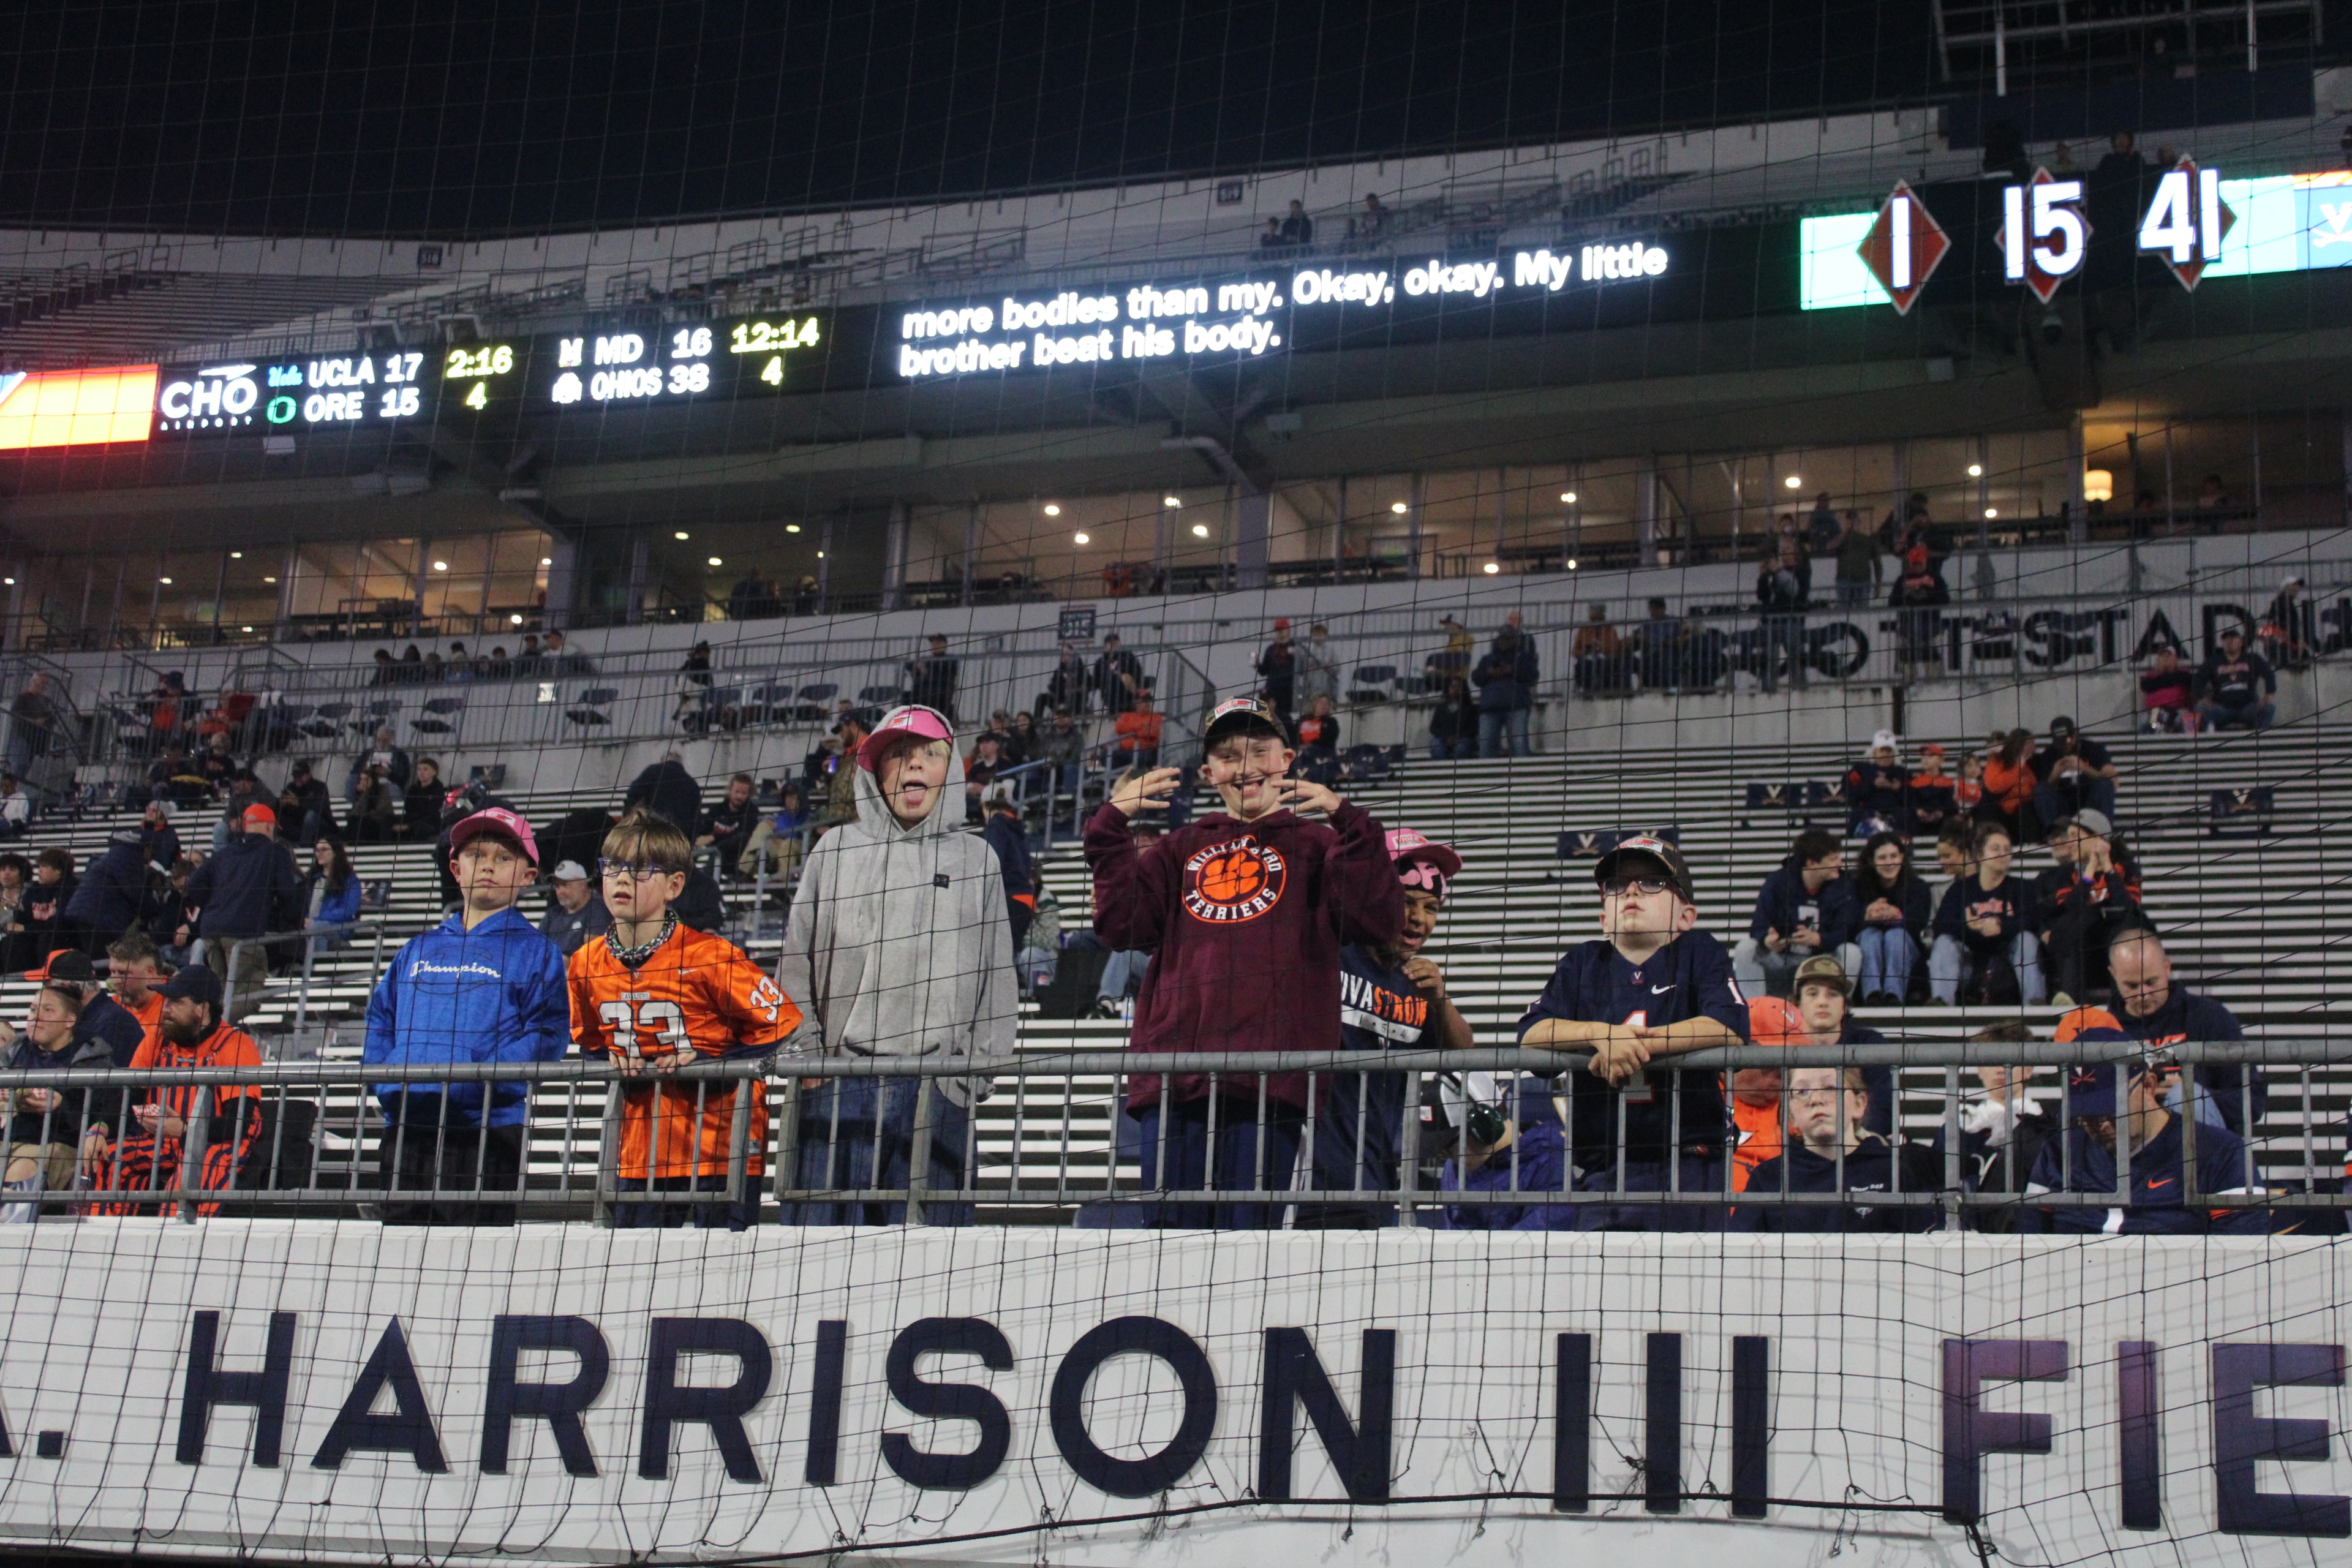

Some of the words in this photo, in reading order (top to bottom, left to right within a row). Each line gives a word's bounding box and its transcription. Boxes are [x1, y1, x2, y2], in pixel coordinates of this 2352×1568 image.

[2003, 180, 2086, 282] 15
[2138, 168, 2222, 264] 41
[902, 306, 994, 338] more
[1002, 292, 1118, 330] bodies
[1126, 285, 1208, 320] than
[1218, 281, 1283, 315] my.
[1292, 269, 1394, 306] Okay,
[1404, 260, 1504, 297] okay.
[1515, 249, 1572, 291] My
[1581, 242, 1668, 281] little
[594, 334, 644, 366] MD
[671, 327, 713, 359] 16
[730, 317, 820, 353] 12:14
[900, 338, 1027, 377] brother
[1033, 329, 1114, 366] beat
[1121, 323, 1175, 358] his
[1184, 314, 1281, 355] body.
[308, 356, 375, 389] UCLA
[384, 353, 424, 383] 17
[447, 345, 513, 379] 2:16
[761, 355, 783, 386] 4
[160, 377, 258, 420] CHO
[466, 381, 488, 411] 4
[590, 366, 663, 401] OHIOS
[668, 363, 710, 394] 38
[304, 391, 365, 423] ORE
[379, 387, 420, 418] 15
[1188, 837, 1250, 871] WILLIAM
[1185, 887, 1277, 920] TERRIERS
[410, 960, 502, 978] Champion
[750, 976, 785, 1022] 33
[598, 1001, 695, 1058] 33
[175, 1308, 1396, 1504] HARRISON
[1553, 1332, 1770, 1518] III
[1939, 1338, 2352, 1539] FIE
